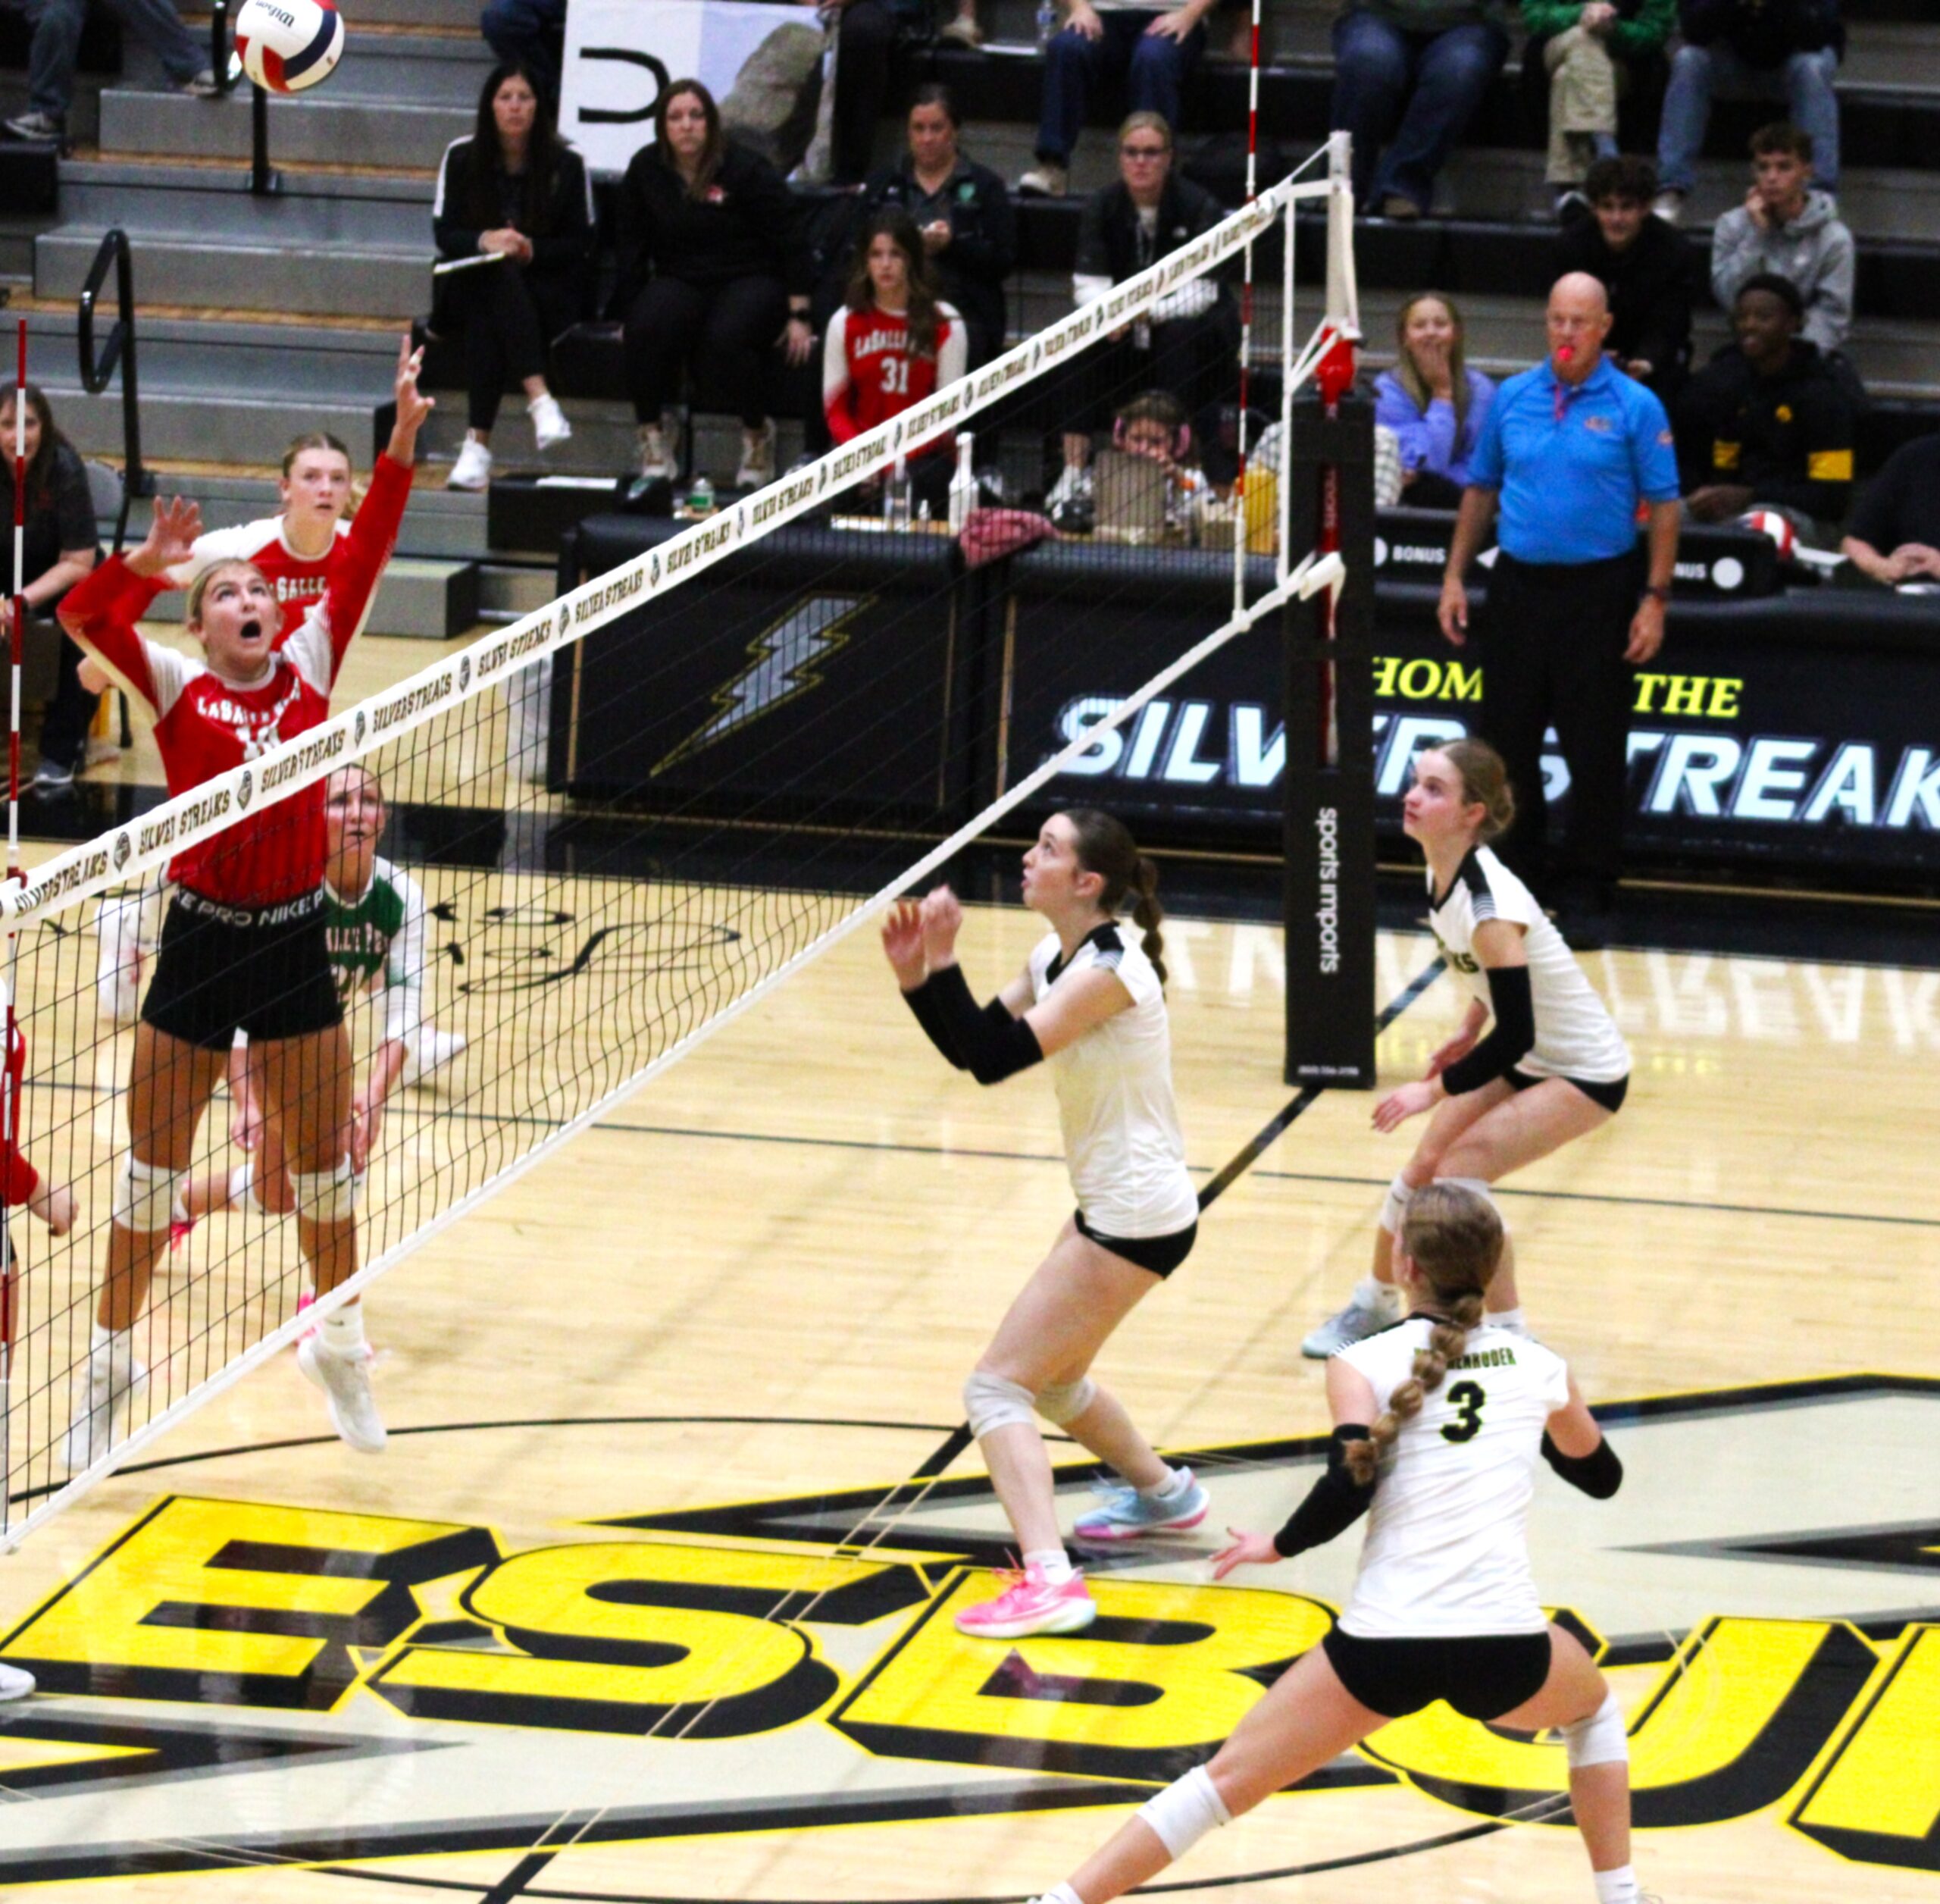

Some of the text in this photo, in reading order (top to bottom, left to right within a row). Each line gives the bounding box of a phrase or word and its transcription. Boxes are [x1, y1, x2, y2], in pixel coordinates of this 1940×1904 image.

[880, 356, 909, 395] 31
[1392, 543, 1447, 565] BONUS
[1633, 673, 1743, 719] THE
[1050, 695, 1469, 796] SILVR
[139, 788, 231, 856] SILVER STREAKS
[1315, 807, 1341, 974] sports imports
[1441, 1380, 1486, 1444] 3
